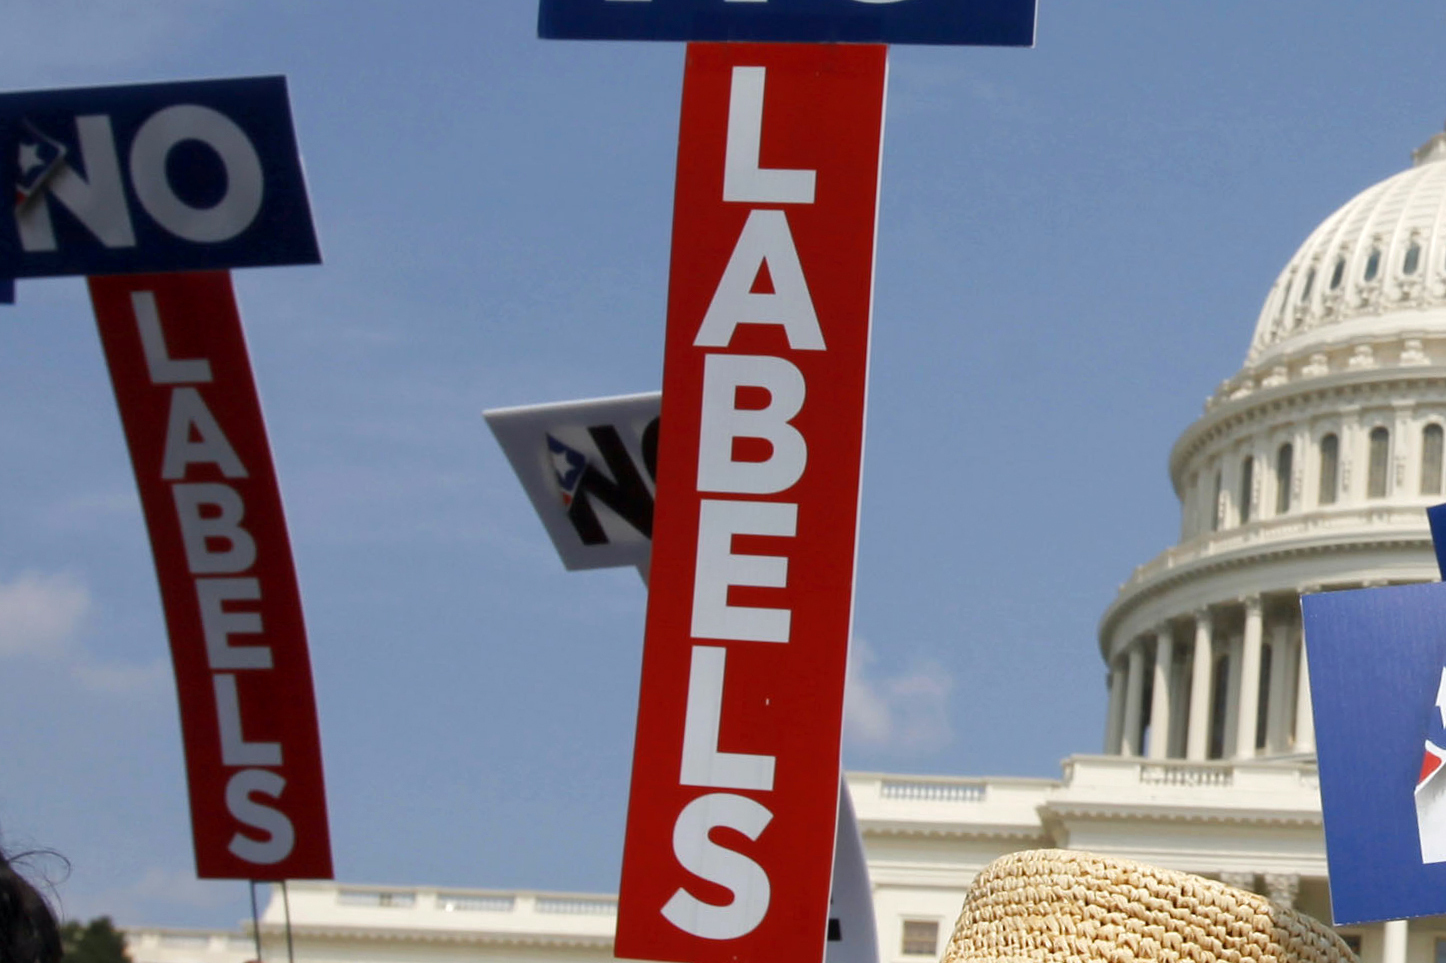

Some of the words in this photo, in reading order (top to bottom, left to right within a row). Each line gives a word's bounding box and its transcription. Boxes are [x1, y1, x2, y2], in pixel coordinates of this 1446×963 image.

[14, 103, 264, 252] NO
[130, 290, 295, 864] LABELS
[553, 416, 660, 546] N
[660, 65, 827, 940] LABELS
